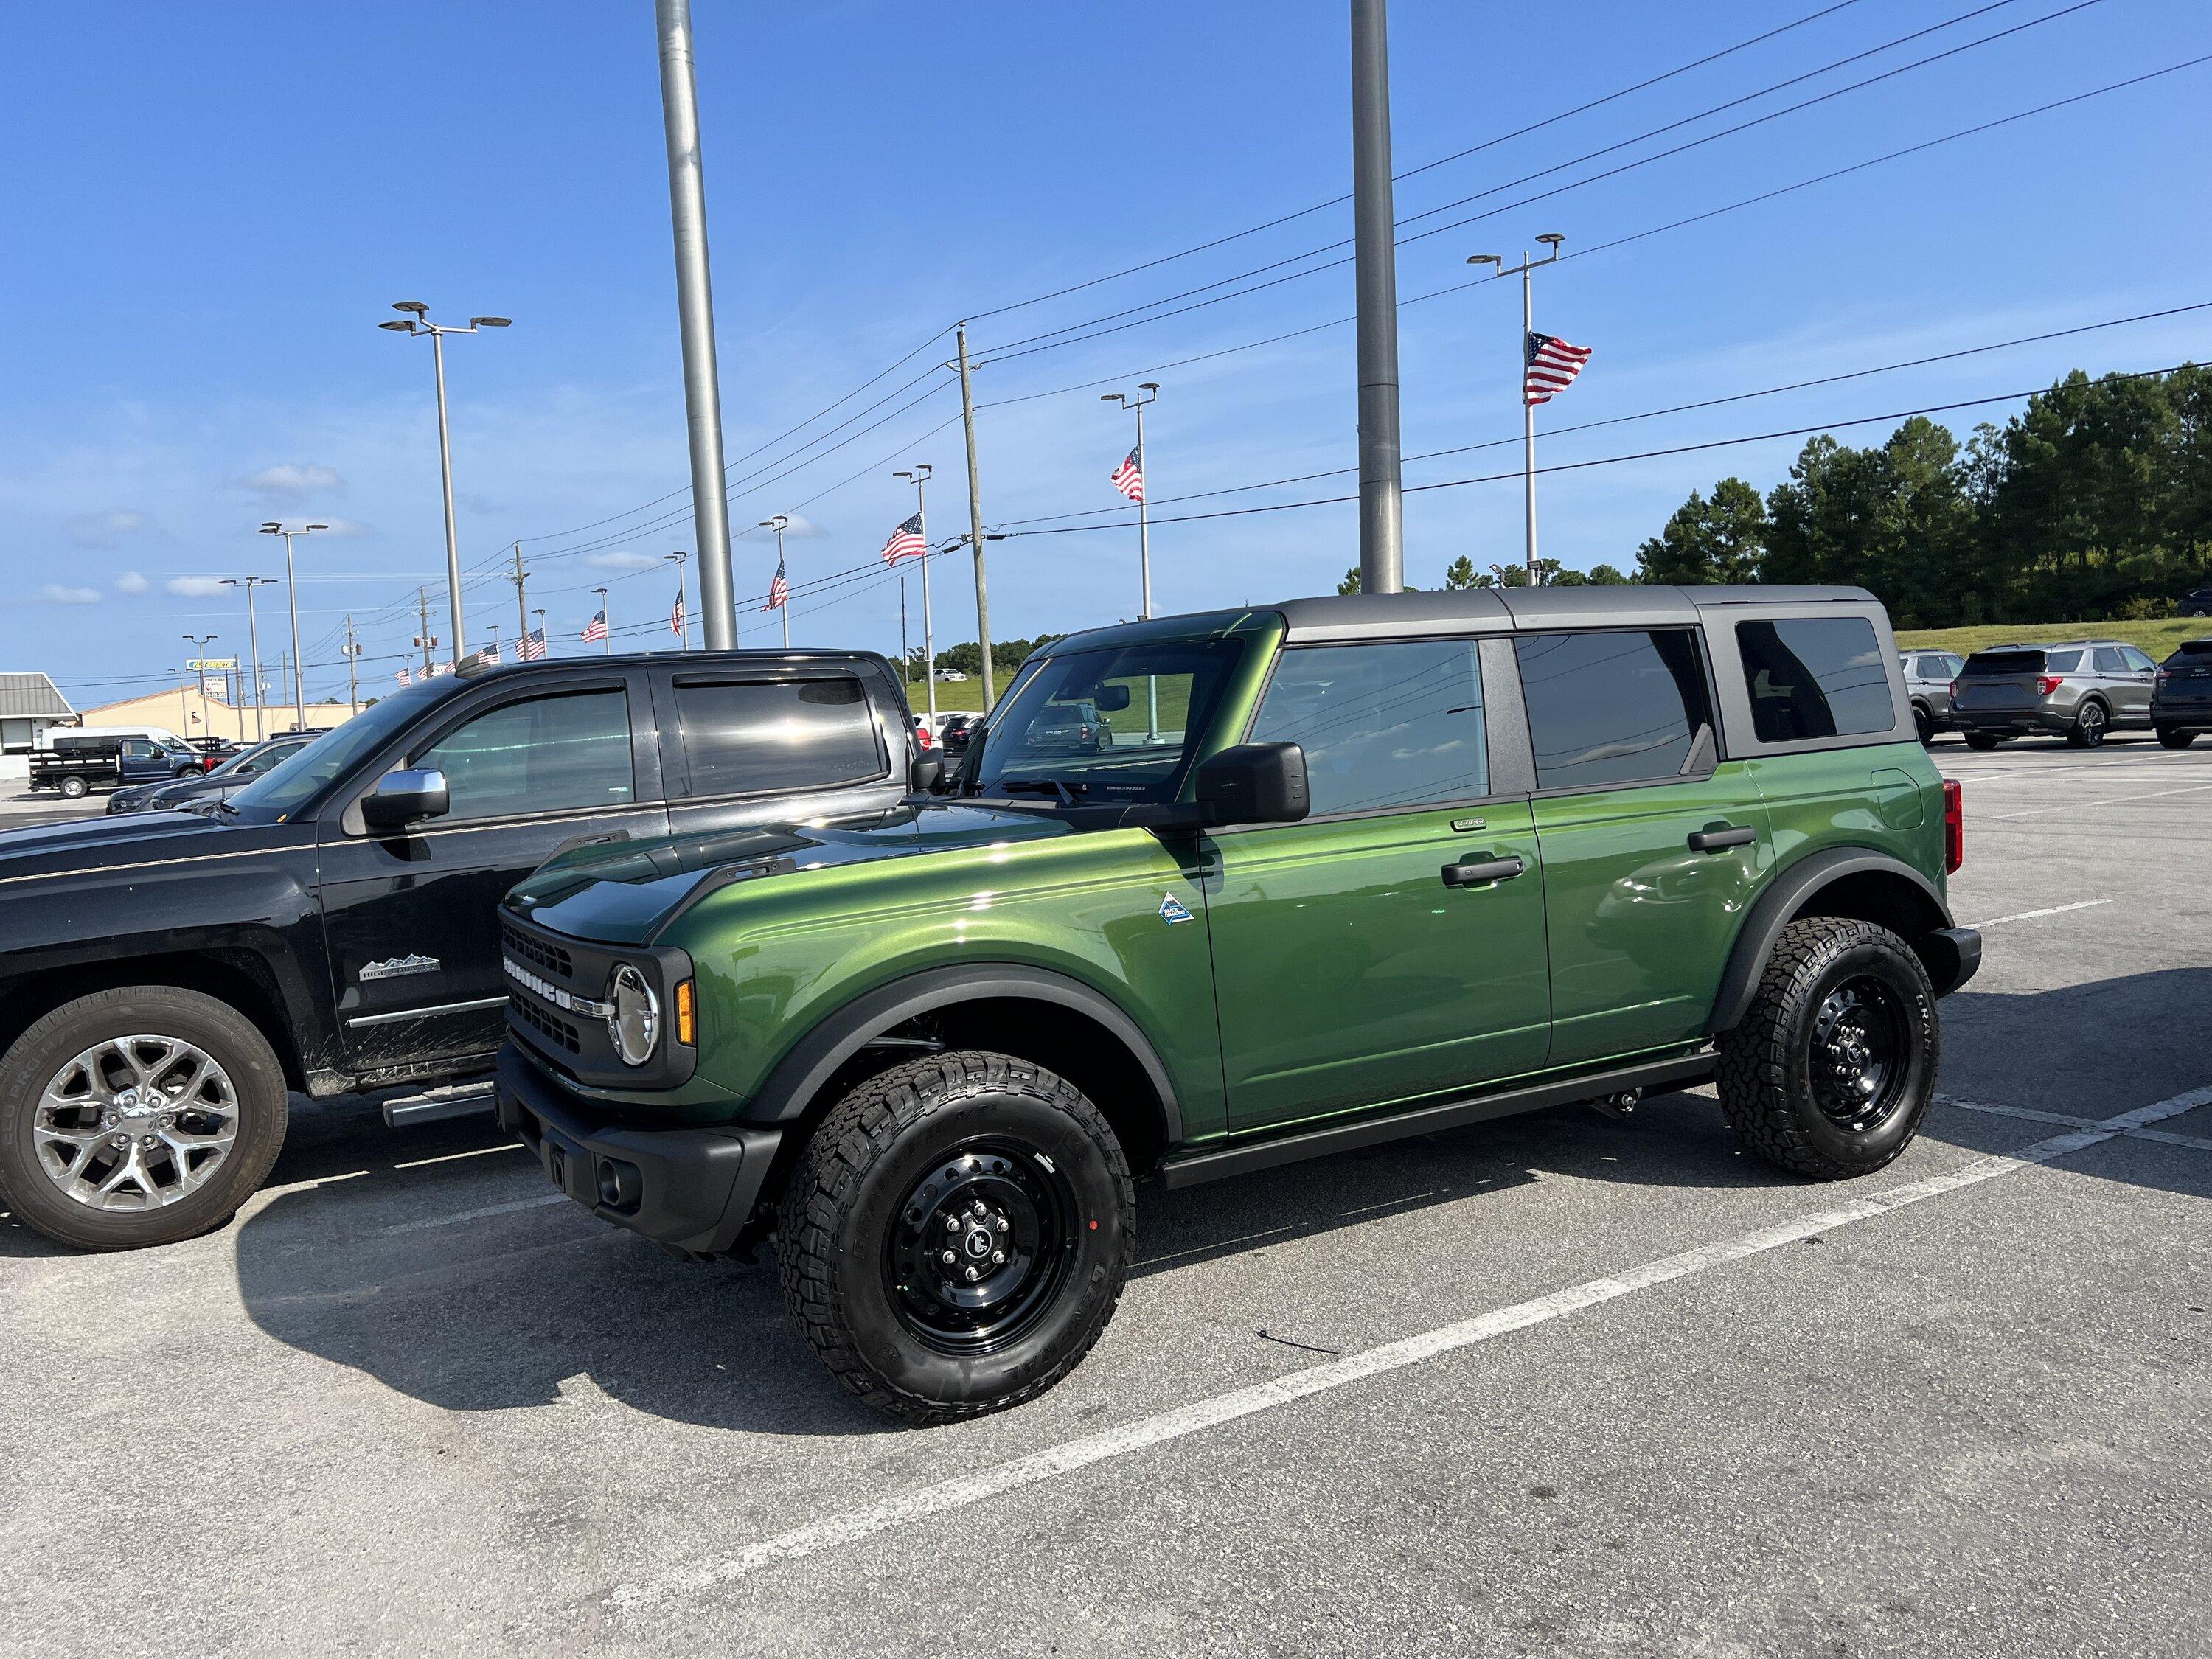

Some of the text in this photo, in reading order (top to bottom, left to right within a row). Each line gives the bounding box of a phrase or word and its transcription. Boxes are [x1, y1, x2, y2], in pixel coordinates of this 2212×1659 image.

[363, 963, 437, 978] HIGH COUNTRY
[1001, 1262, 1106, 1382] GENERAL
